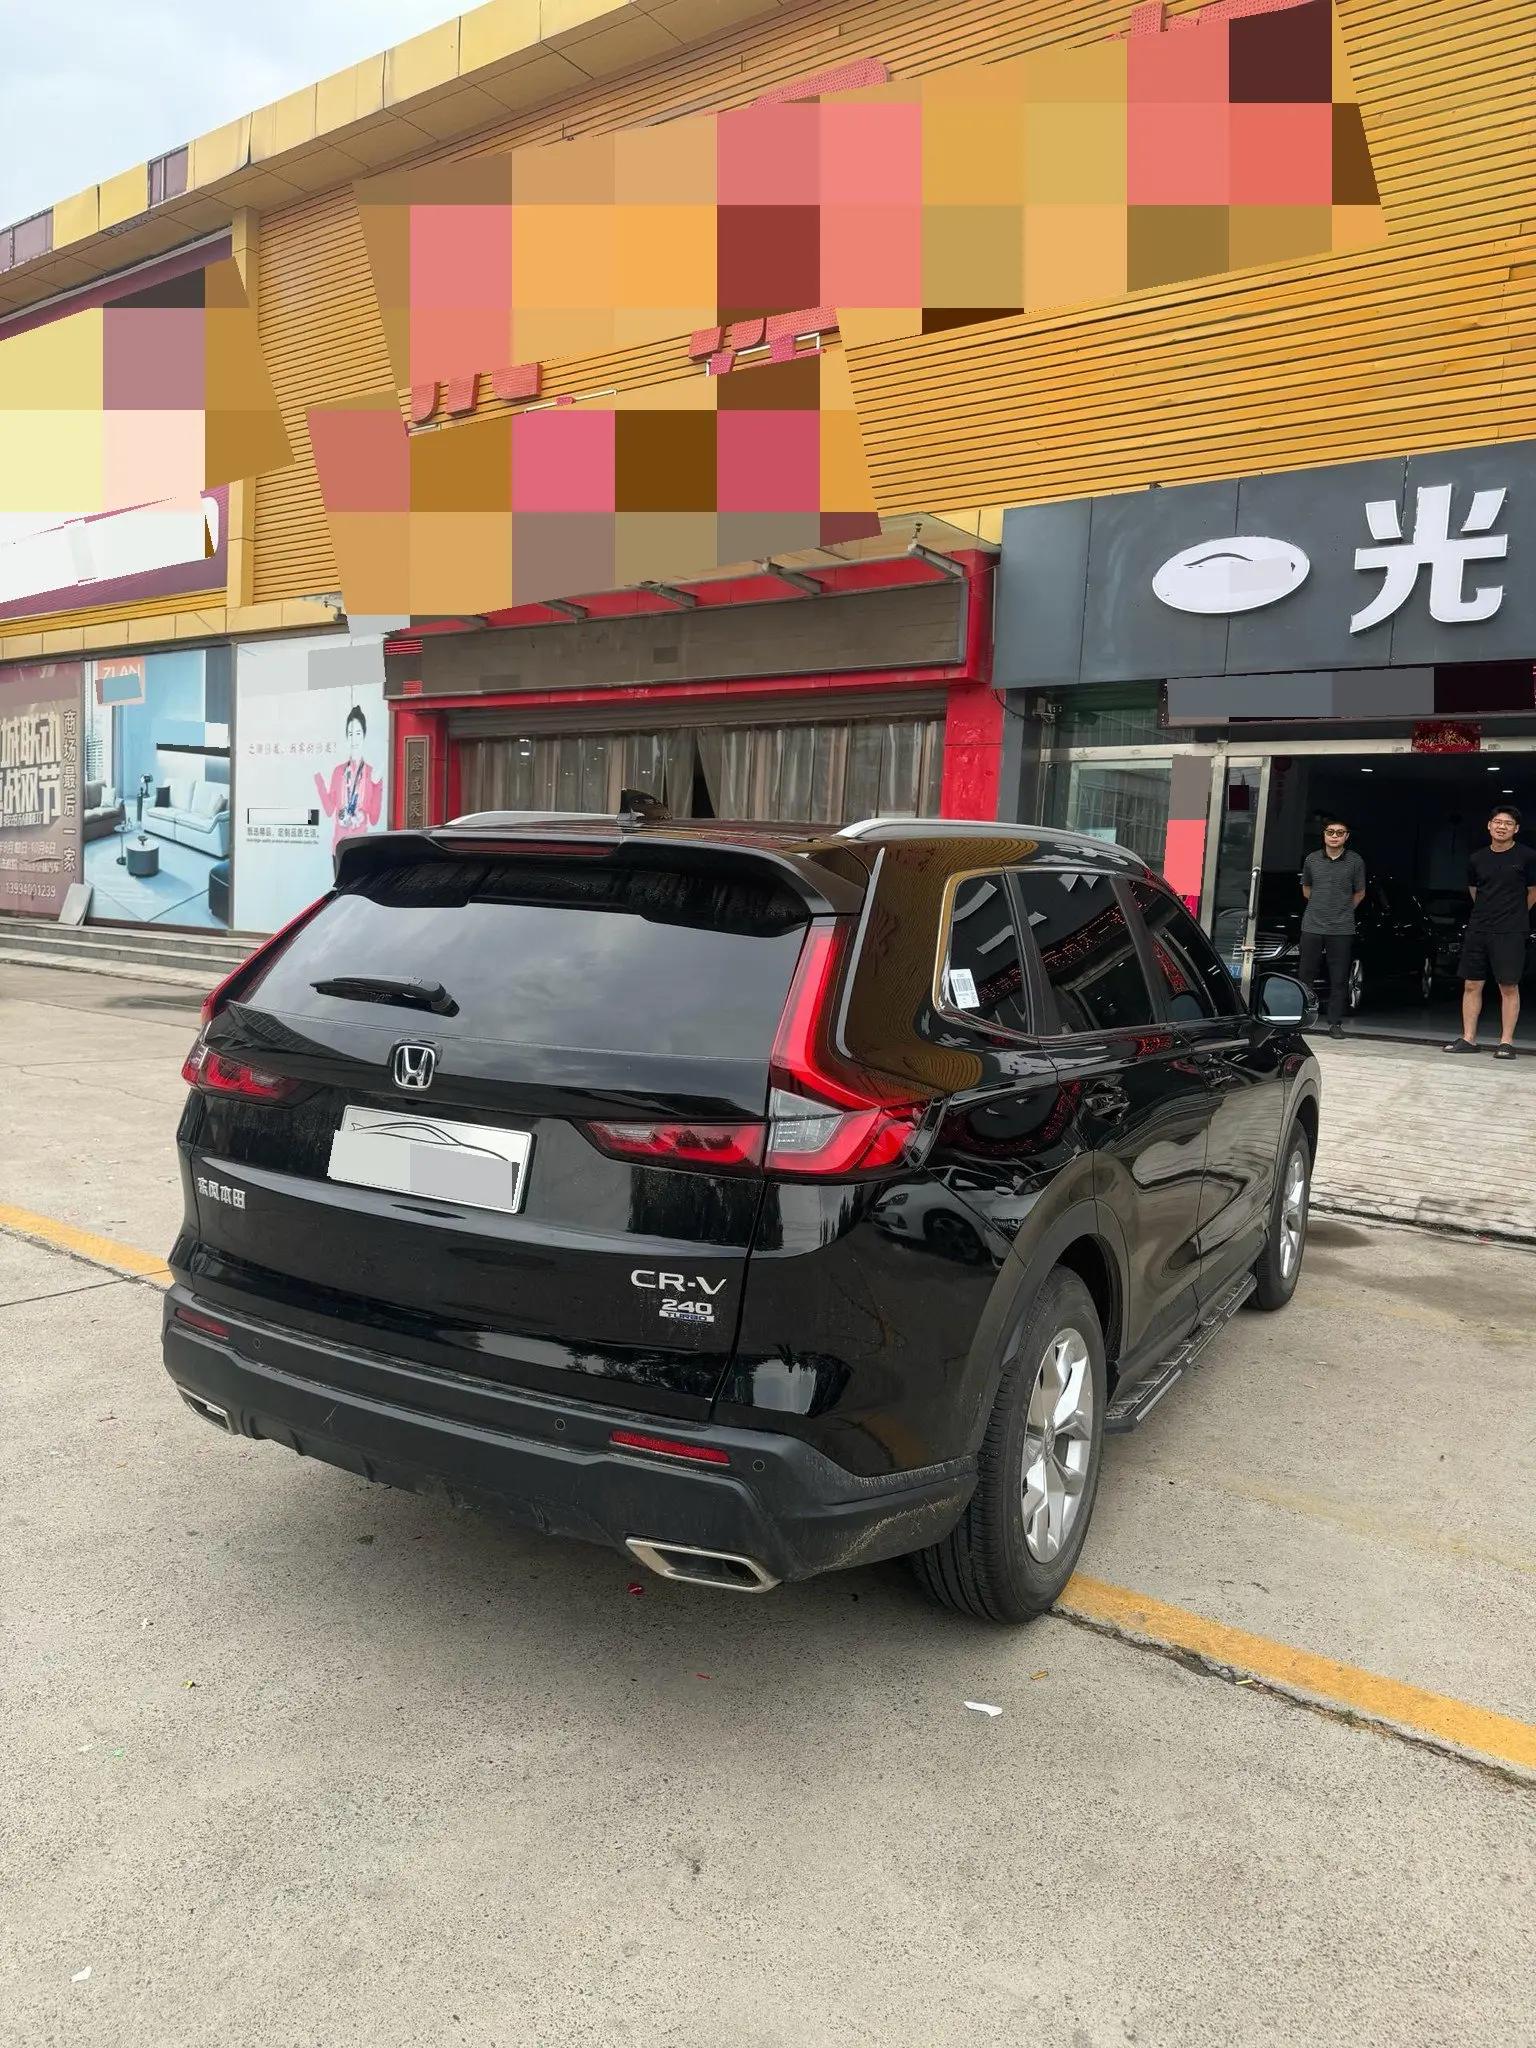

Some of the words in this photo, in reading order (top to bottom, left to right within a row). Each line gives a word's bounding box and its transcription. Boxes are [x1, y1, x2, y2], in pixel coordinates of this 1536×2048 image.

[1349, 483, 1508, 633] 光
[0, 763, 61, 824] 战双节
[197, 1177, 246, 1209] 东风本田
[630, 1269, 727, 1295] CR-V
[661, 1298, 712, 1315] 240
